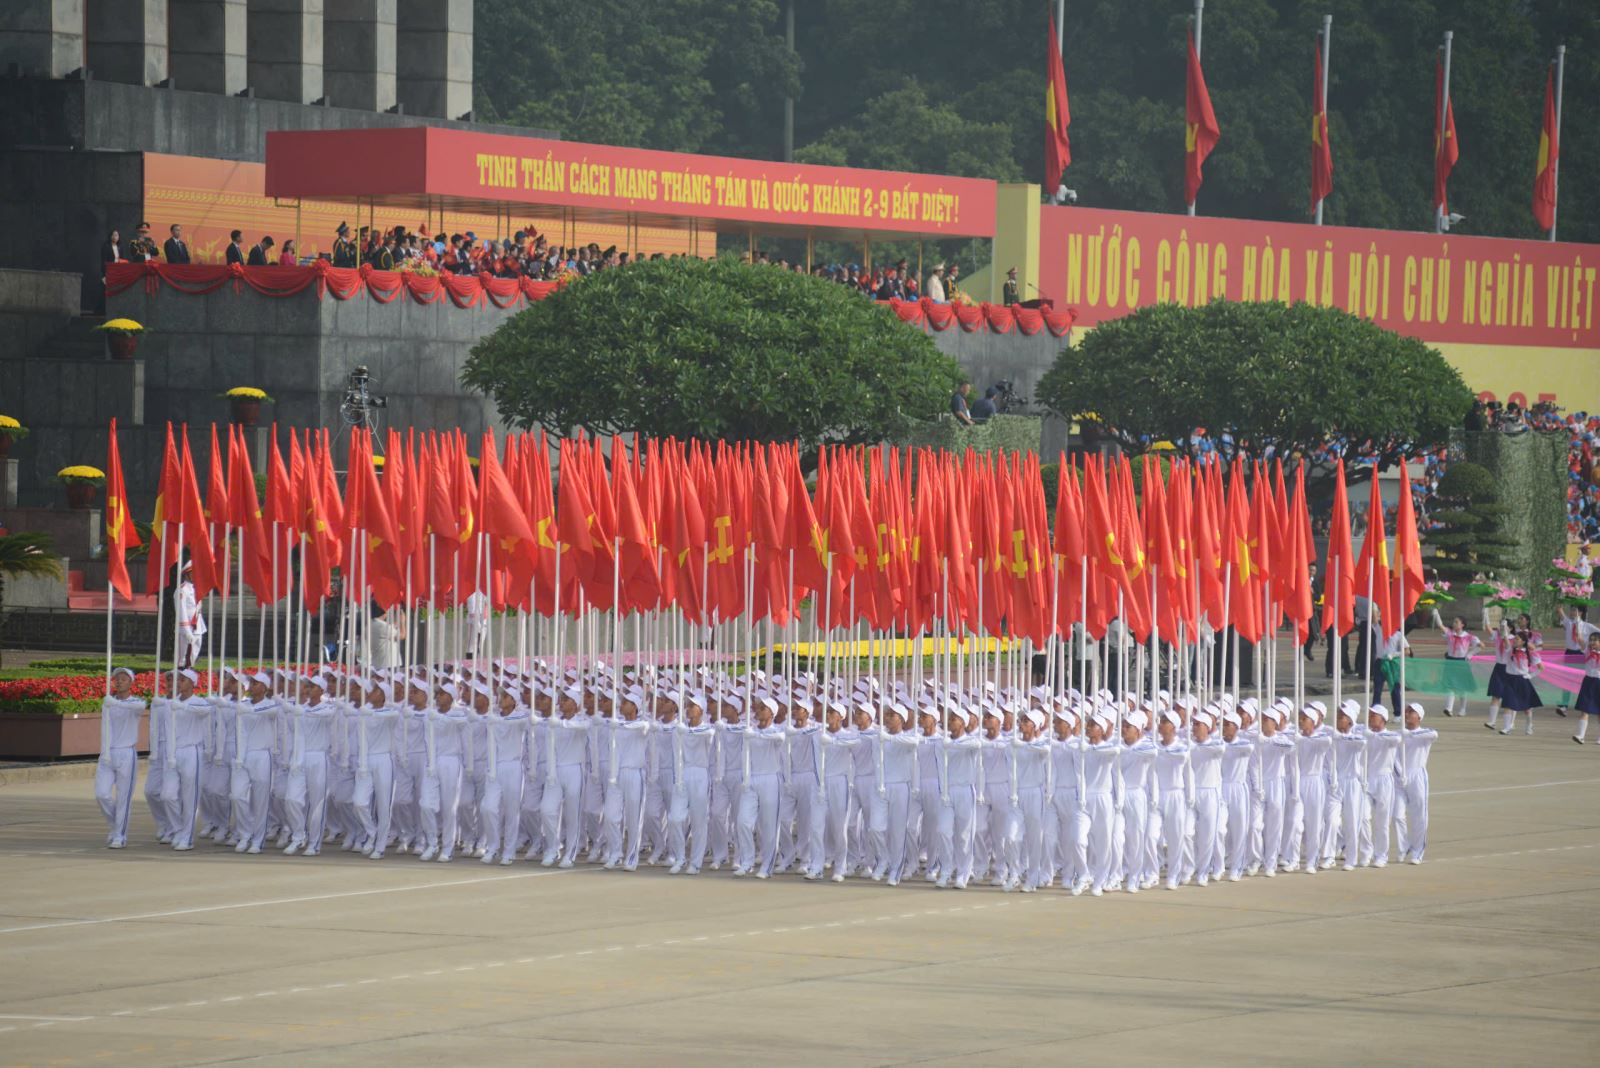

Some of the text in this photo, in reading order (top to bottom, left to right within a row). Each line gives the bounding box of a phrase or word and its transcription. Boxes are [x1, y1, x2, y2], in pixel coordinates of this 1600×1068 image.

[476, 153, 517, 188] TINH
[569, 157, 610, 196] CÁCH
[614, 167, 657, 204] MẠNG
[661, 167, 711, 205] THÁNG
[715, 171, 747, 207] TÁM
[751, 174, 769, 209] VÀ
[772, 174, 809, 213] QUỐC
[813, 179, 860, 216] KHÁNH
[863, 188, 889, 218] 2-9
[892, 182, 919, 221] BẤT
[1066, 223, 1141, 309] NƯỚC
[1156, 228, 1228, 308] CÔNG
[1242, 235, 1291, 308] HÒA
[1304, 239, 1334, 308] XÃ
[1403, 241, 1451, 324] CHỦ
[1463, 253, 1534, 327] NGHĨA
[1547, 255, 1597, 341] VIỆT
